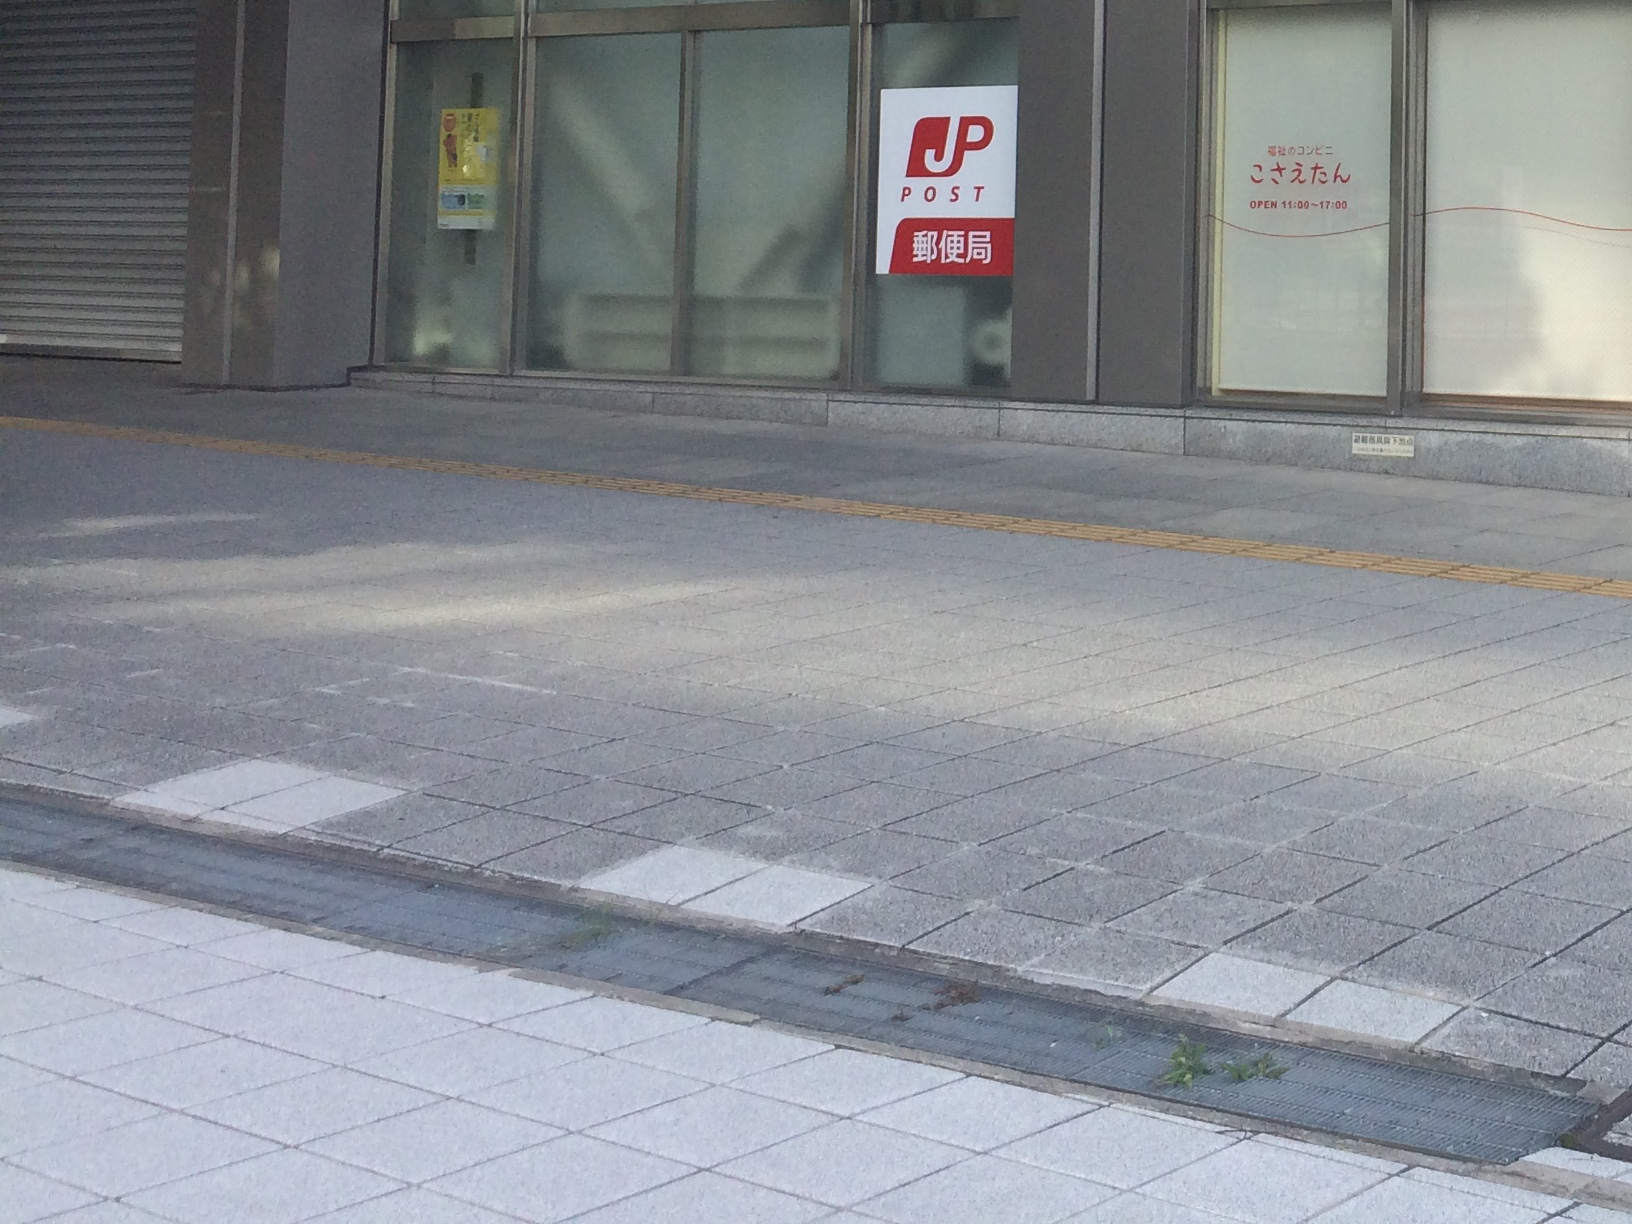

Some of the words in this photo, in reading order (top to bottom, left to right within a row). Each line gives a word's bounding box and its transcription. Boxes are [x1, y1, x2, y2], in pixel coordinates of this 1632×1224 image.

[905, 115, 995, 178] JP
[1267, 145, 1334, 157] 福祉のコンビニ
[1250, 161, 1351, 185] こさえたん
[900, 185, 985, 203] POST
[1249, 200, 1278, 210] OPEN
[911, 229, 993, 264] 郵便局
